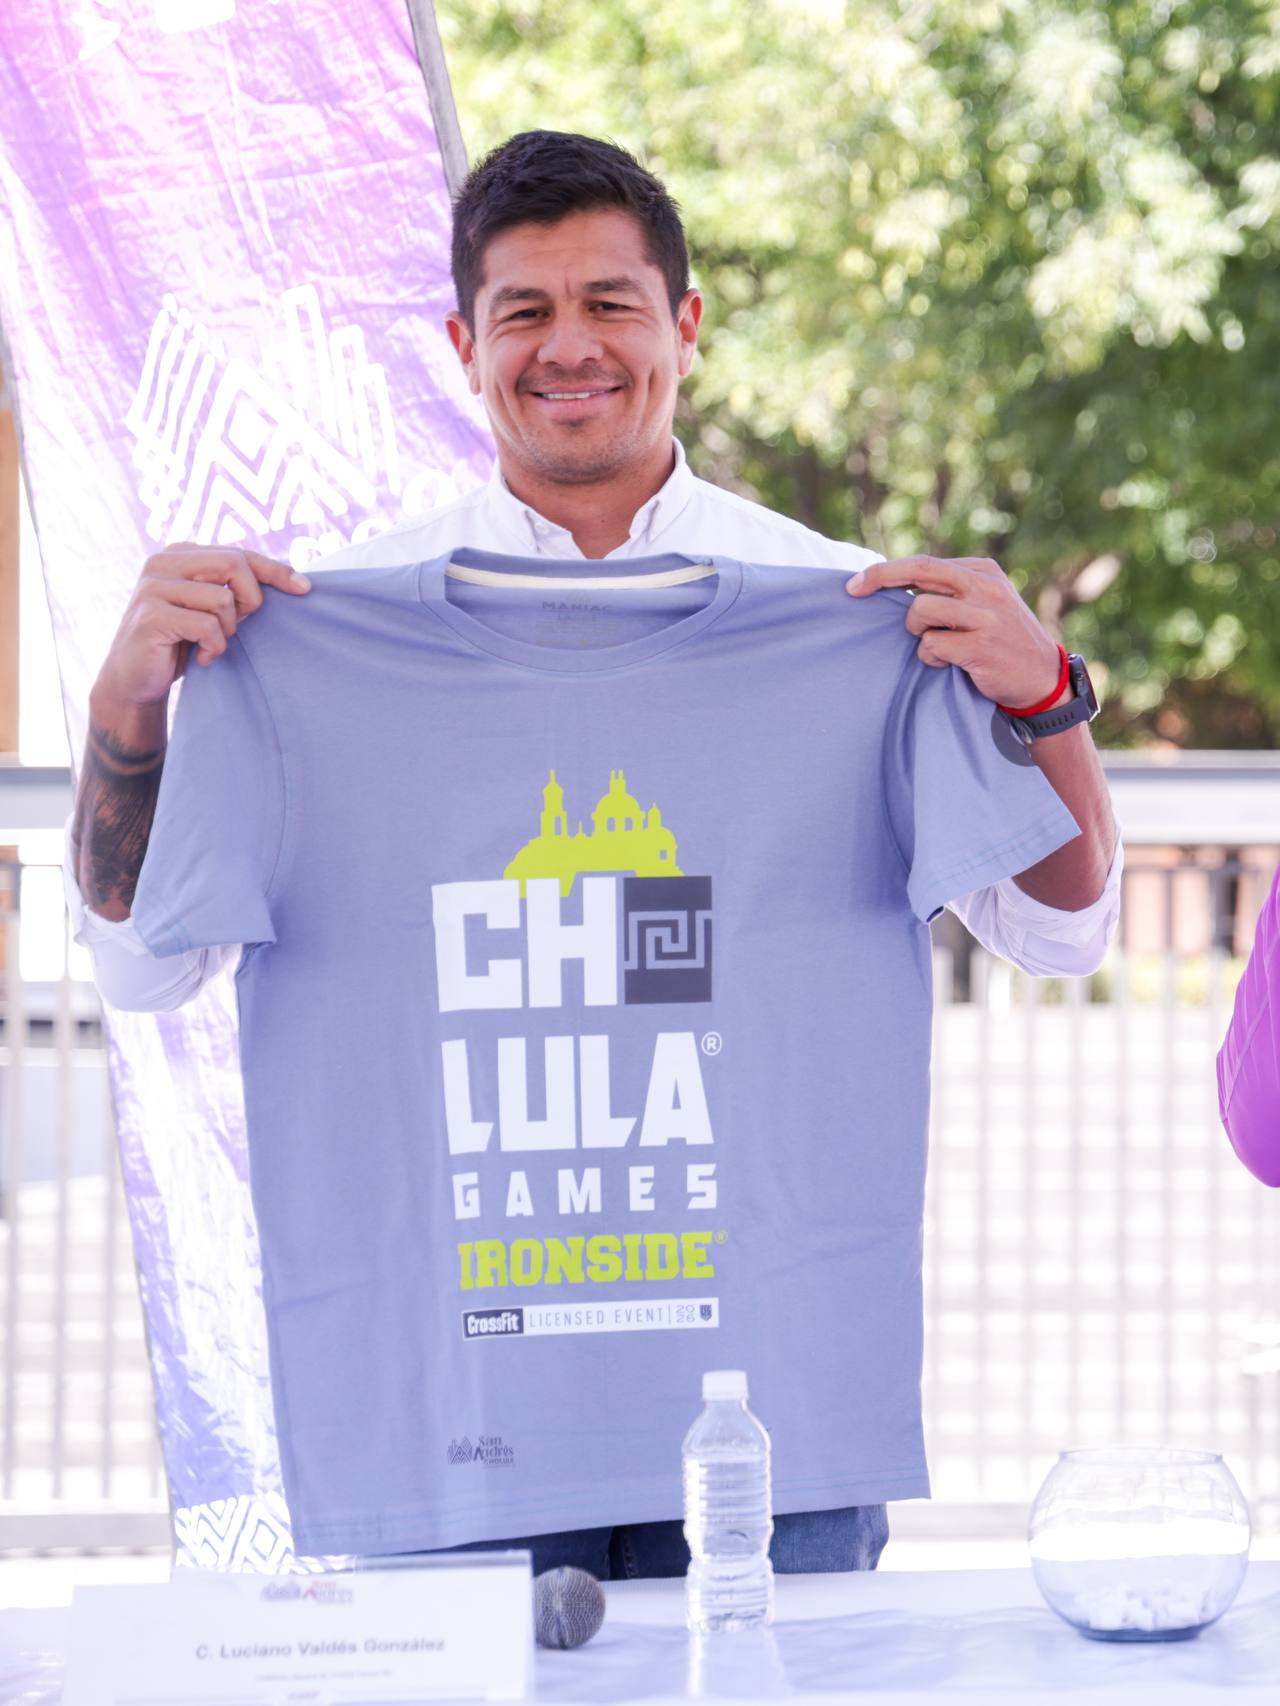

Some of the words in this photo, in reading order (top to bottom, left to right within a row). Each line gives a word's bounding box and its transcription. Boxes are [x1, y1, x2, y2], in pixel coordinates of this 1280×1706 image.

[452, 1163, 718, 1220] GAMES
[529, 1309, 605, 1328] LICENSED
[615, 1306, 663, 1324] EVENT
[196, 1645, 213, 1661] C.
[220, 1642, 292, 1660] Luciano
